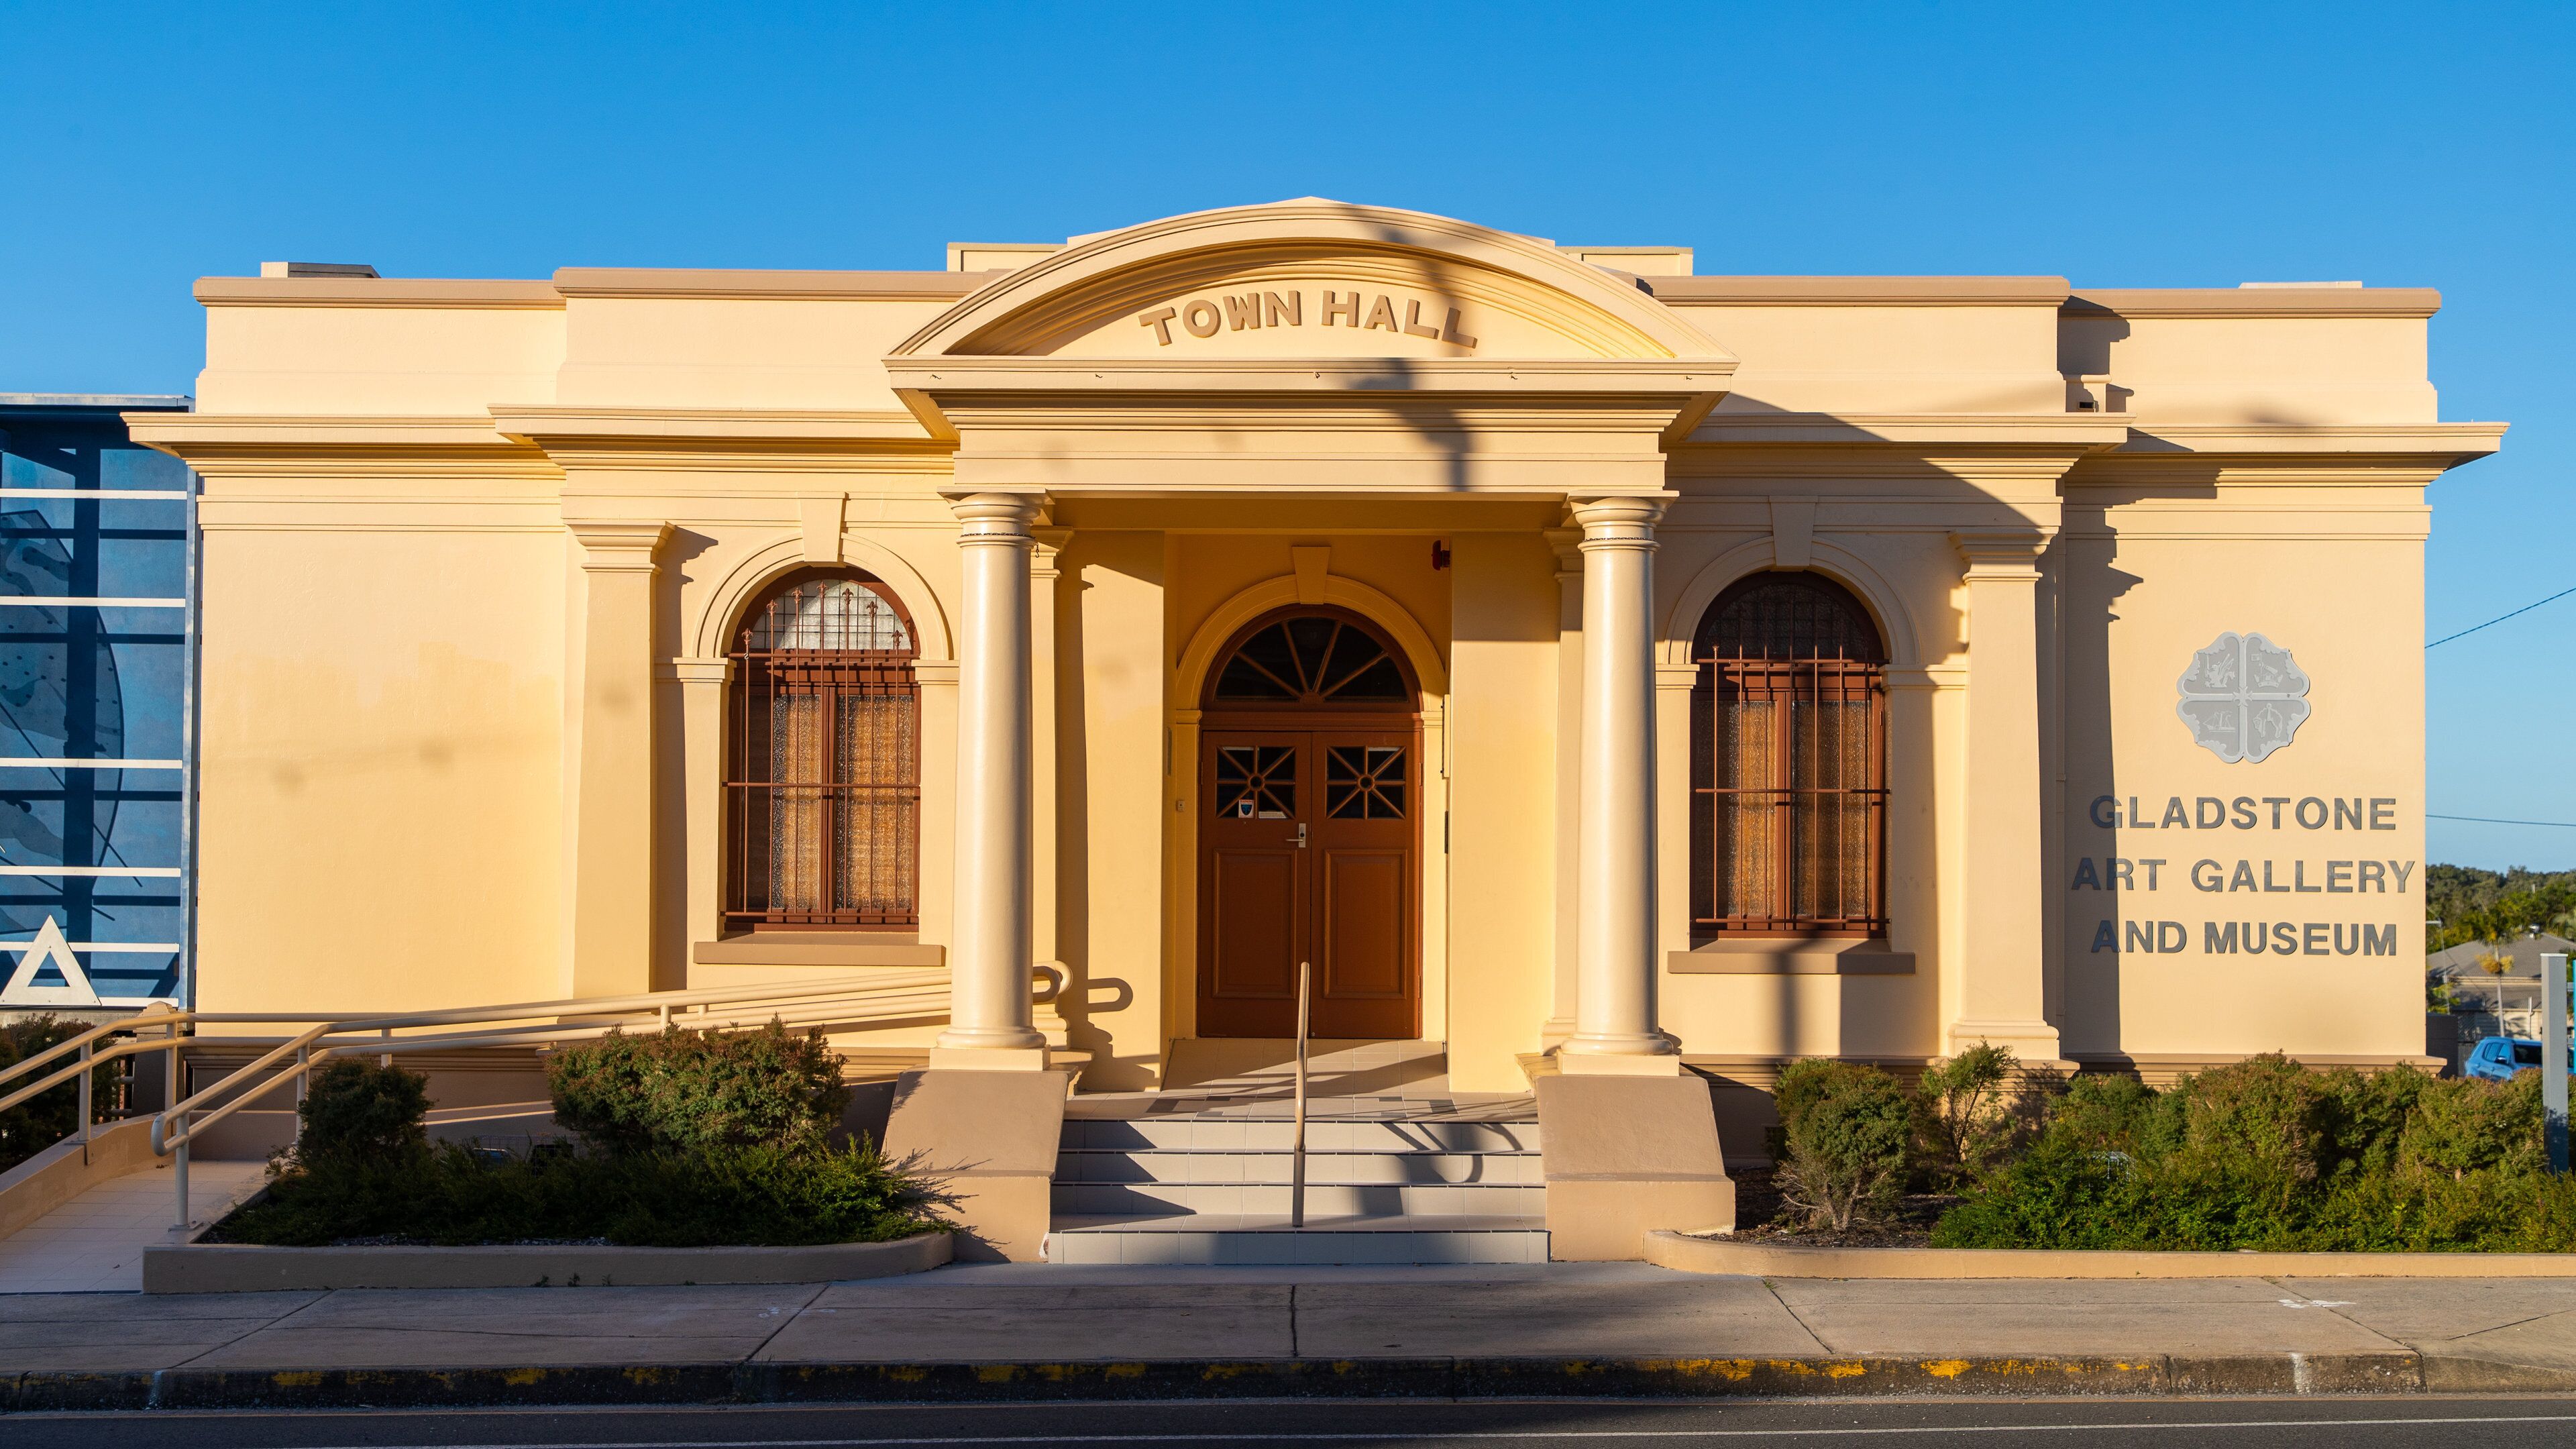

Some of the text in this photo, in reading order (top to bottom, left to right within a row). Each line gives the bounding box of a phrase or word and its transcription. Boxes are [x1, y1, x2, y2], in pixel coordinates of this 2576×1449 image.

[1138, 290, 1479, 348] TOWN HALL
[2089, 795, 2396, 830] GLADSTONE
[2071, 857, 2415, 893] ART GALLERY
[2090, 920, 2397, 956] AND MUSEUM
